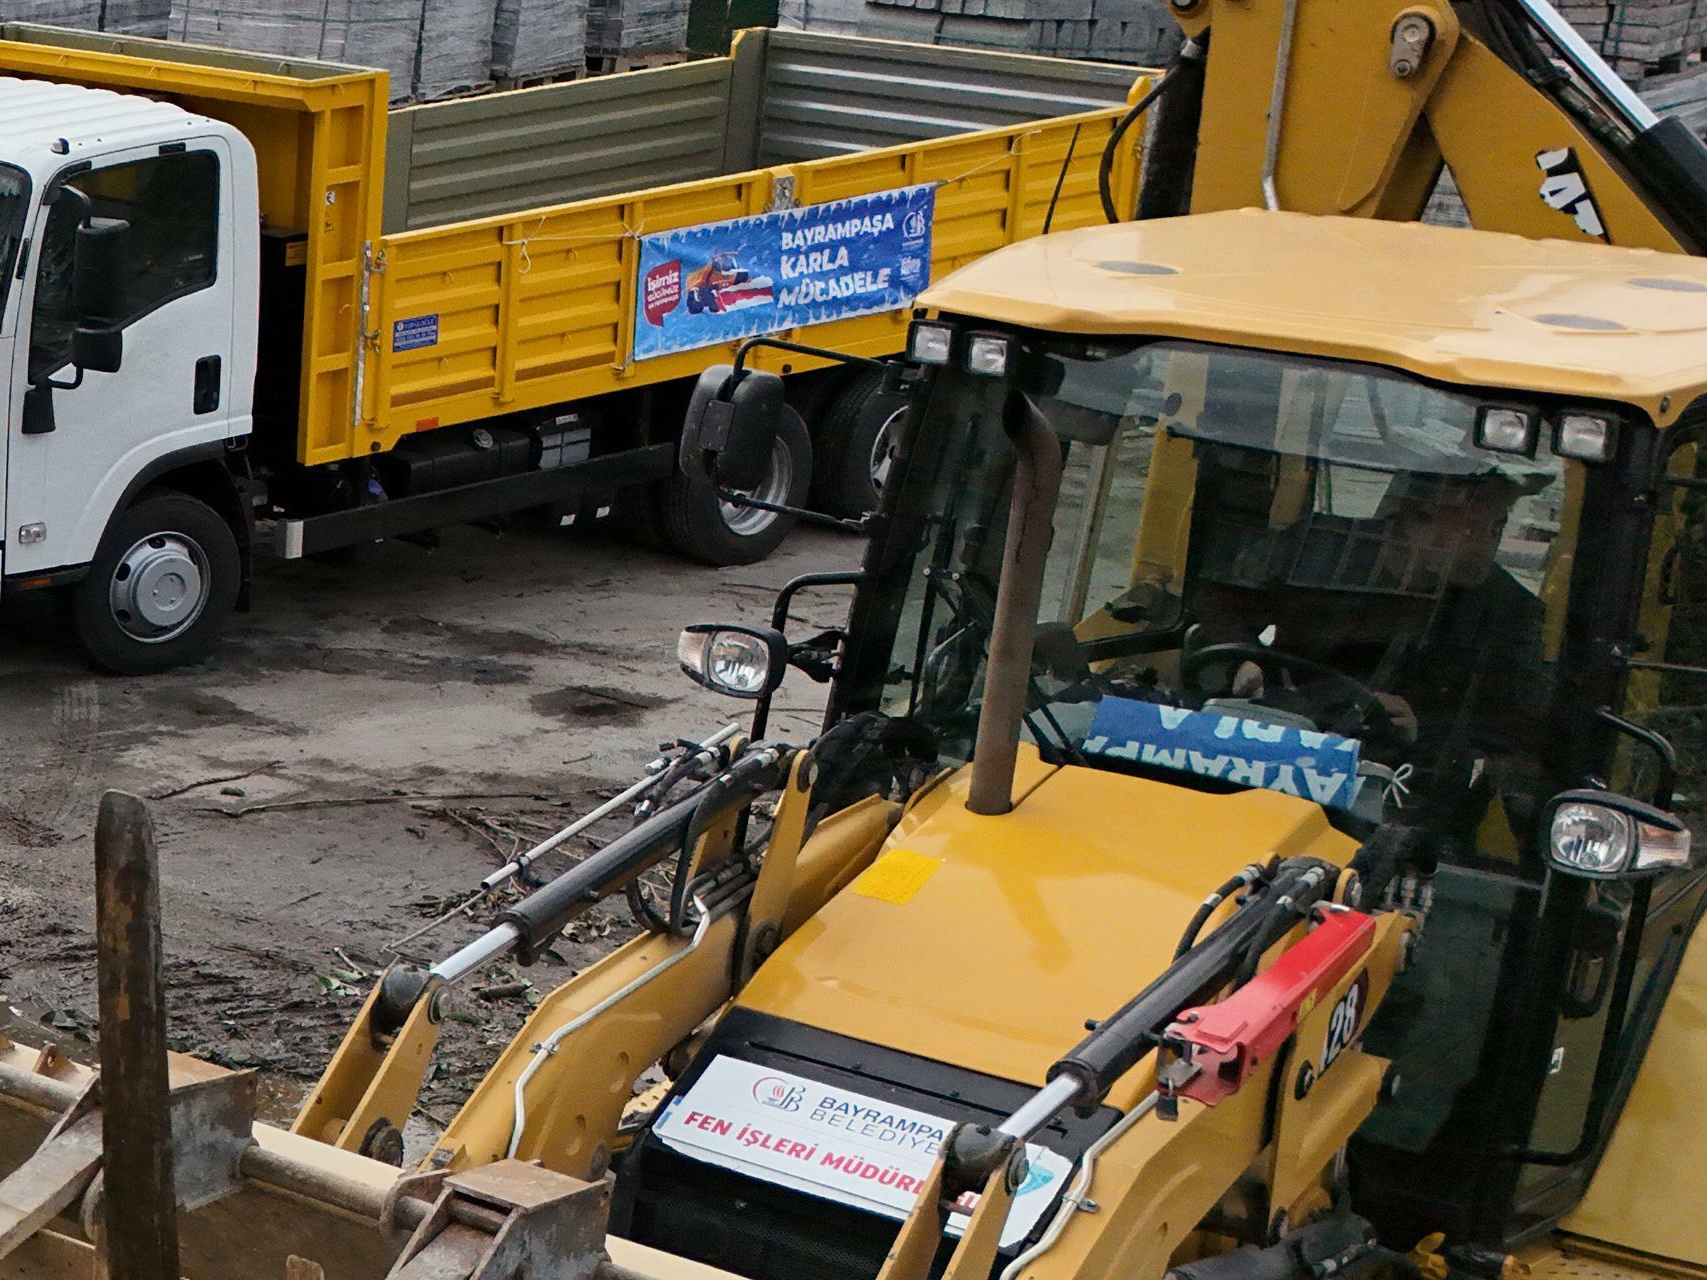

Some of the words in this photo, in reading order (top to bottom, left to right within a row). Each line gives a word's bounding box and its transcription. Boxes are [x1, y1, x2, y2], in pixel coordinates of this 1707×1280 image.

[781, 213, 894, 251] BAYRAMPAŞA
[780, 246, 849, 280] KARLA
[777, 268, 891, 308] MÜCADELE
[684, 1110, 732, 1136] FEN
[736, 1121, 819, 1162] İŞLERİ
[818, 1096, 946, 1142] BAYRAMPA
